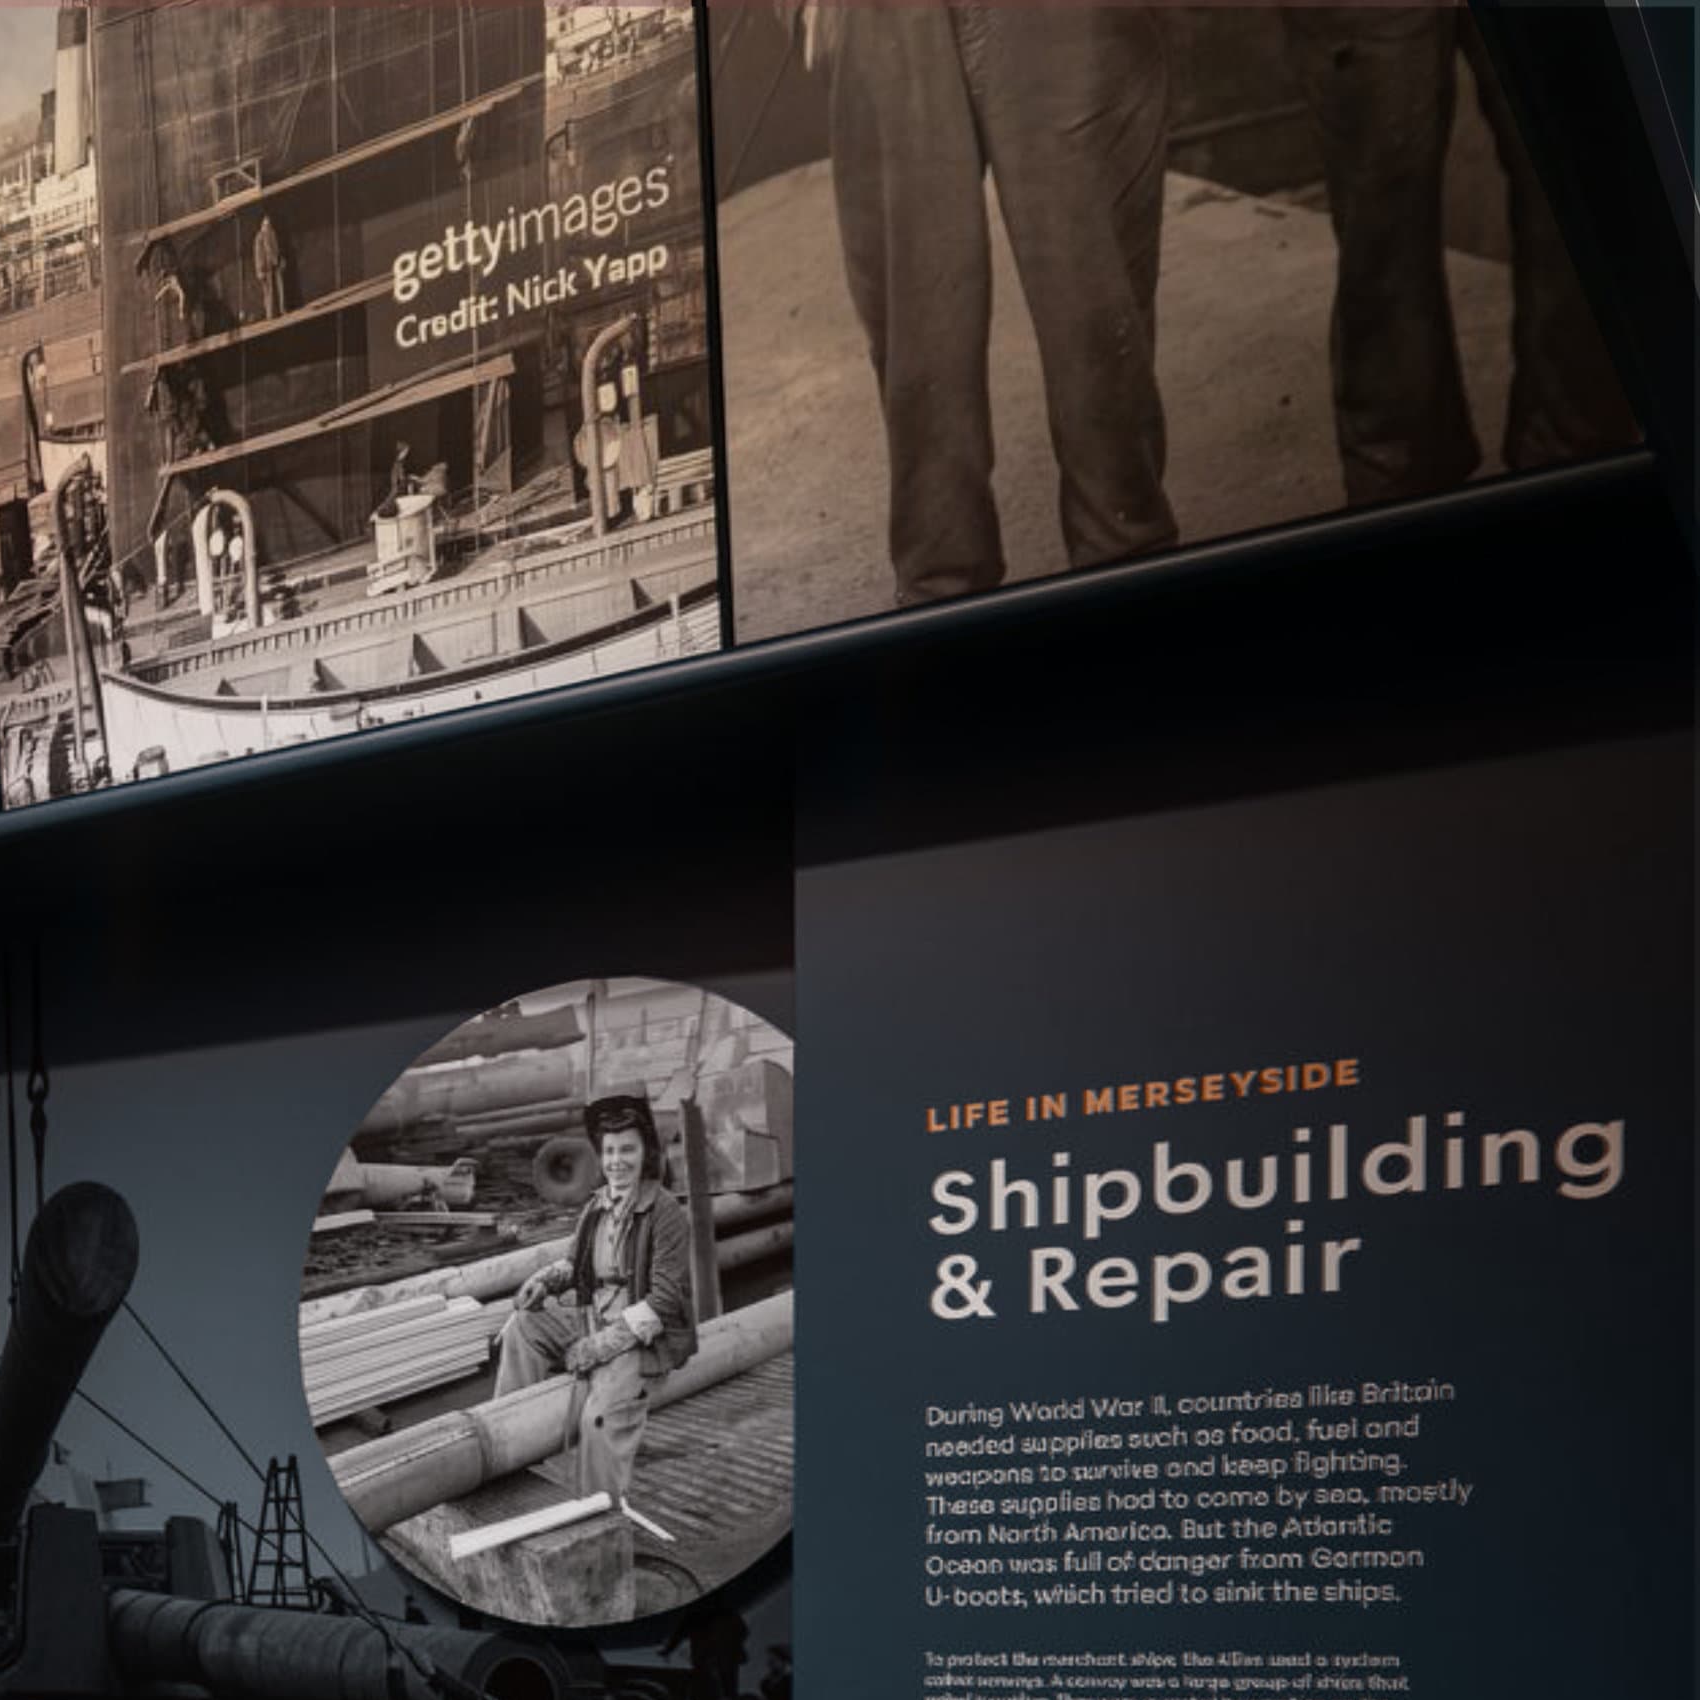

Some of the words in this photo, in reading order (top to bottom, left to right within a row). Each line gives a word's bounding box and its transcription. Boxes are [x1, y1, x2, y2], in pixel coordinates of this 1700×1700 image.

[392, 164, 670, 302] gettyimages
[396, 295, 500, 349] Credit:
[506, 269, 577, 317] Nick
[583, 244, 668, 289] Yapp
[926, 1099, 1010, 1133] LIFE
[1026, 1093, 1068, 1121] IN
[1084, 1058, 1360, 1115] MERSEYSIDE
[928, 1111, 1627, 1239] Shipbuilding
[929, 1253, 996, 1321] &
[1029, 1219, 1363, 1322] Repair
[925, 1404, 1005, 1427] During
[1009, 1399, 1086, 1422] World
[1090, 1398, 1144, 1418] War
[1177, 1390, 1304, 1414] countries
[1308, 1384, 1355, 1406] like
[1361, 1380, 1455, 1404] Britain
[925, 1436, 1016, 1457] needed
[1021, 1430, 1123, 1455] supplies
[1128, 1426, 1188, 1449] such
[1194, 1428, 1225, 1447] as
[1306, 1418, 1358, 1441] fuel
[1364, 1415, 1420, 1439] and
[924, 1468, 1034, 1487] weapons
[1039, 1465, 1067, 1482] to
[1072, 1459, 1159, 1481] survive
[1166, 1457, 1216, 1478] and
[1221, 1456, 1288, 1478] keep
[926, 1495, 996, 1515] These
[1000, 1490, 1101, 1515] supplies
[1106, 1489, 1156, 1510] had
[1159, 1490, 1189, 1509] to
[1196, 1490, 1269, 1508] come
[1276, 1485, 1308, 1509] by
[1379, 1479, 1472, 1504] mostly
[925, 1523, 982, 1545] from
[987, 1523, 1058, 1544] North
[1180, 1518, 1225, 1540] But
[1232, 1519, 1277, 1539] the
[1281, 1514, 1393, 1537] Atlantic
[925, 1555, 1004, 1576] Ocean
[1008, 1557, 1058, 1574] was
[1063, 1550, 1102, 1572] full
[1106, 1550, 1135, 1572] of
[1139, 1552, 1232, 1575] danger
[1239, 1548, 1304, 1569] from
[1033, 1583, 1106, 1605] which
[1110, 1581, 1174, 1605] tried
[1180, 1583, 1208, 1604] to
[1213, 1580, 1265, 1603] sink
[1272, 1581, 1318, 1602] the
